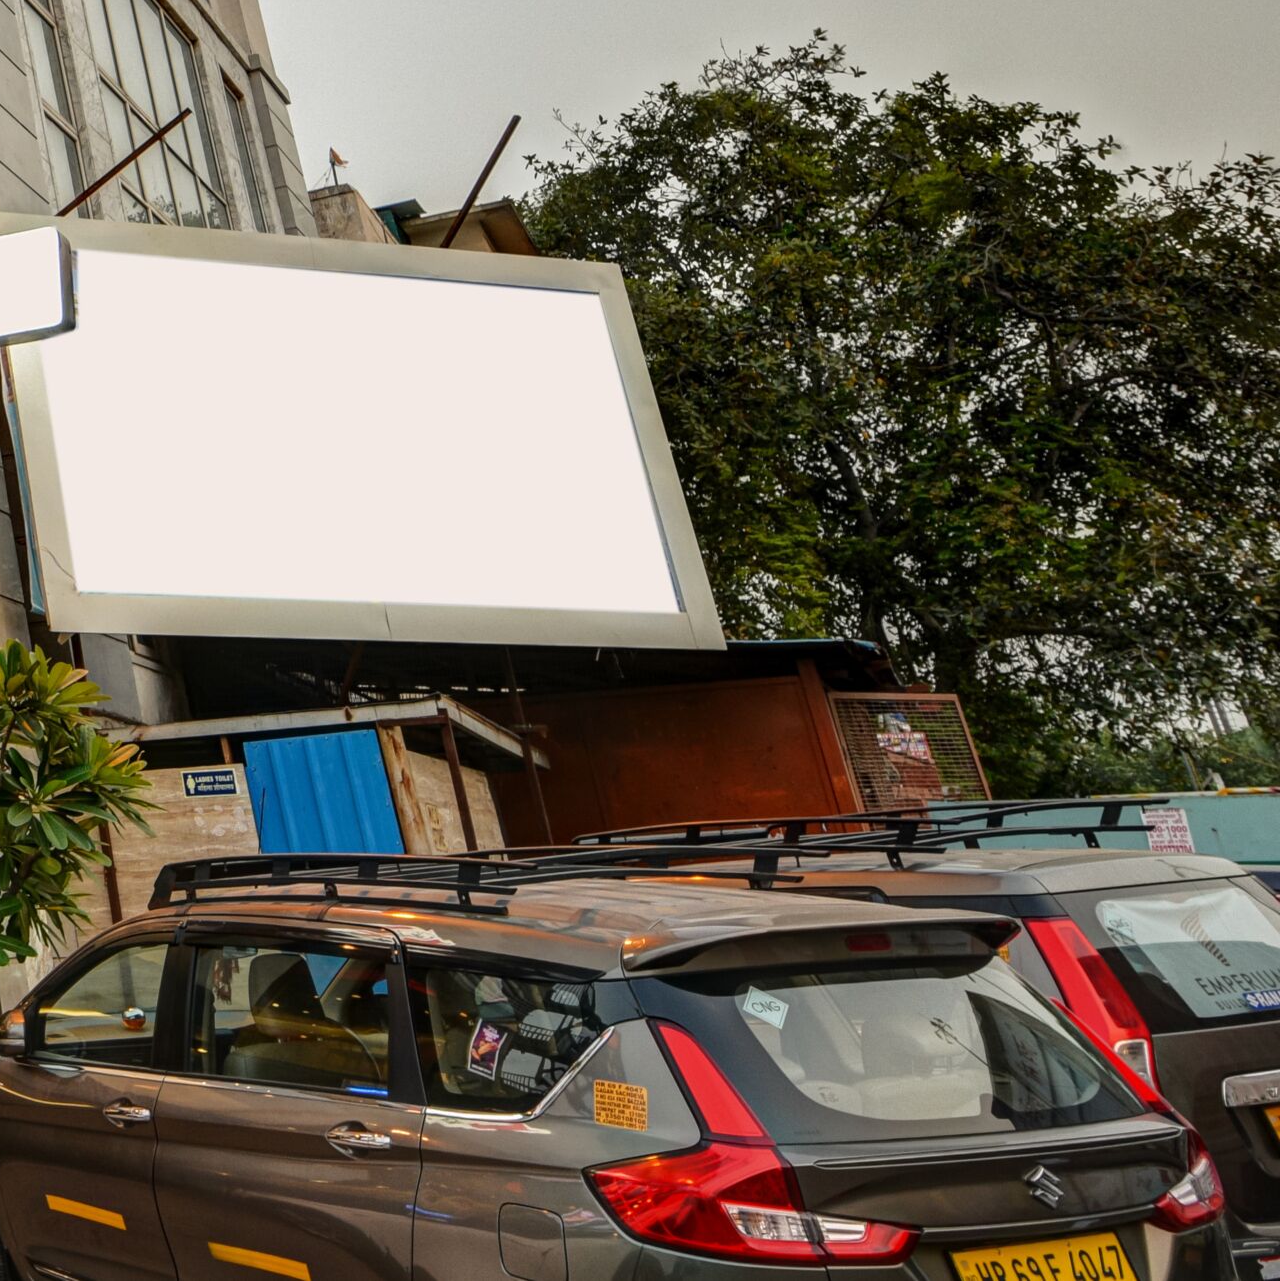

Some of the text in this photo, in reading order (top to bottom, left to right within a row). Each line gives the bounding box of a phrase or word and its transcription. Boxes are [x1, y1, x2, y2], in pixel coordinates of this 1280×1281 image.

[195, 774, 233, 783] LADIES TOILET
[1255, 989, 1280, 1007] RAN
[751, 1000, 781, 1014] CNG
